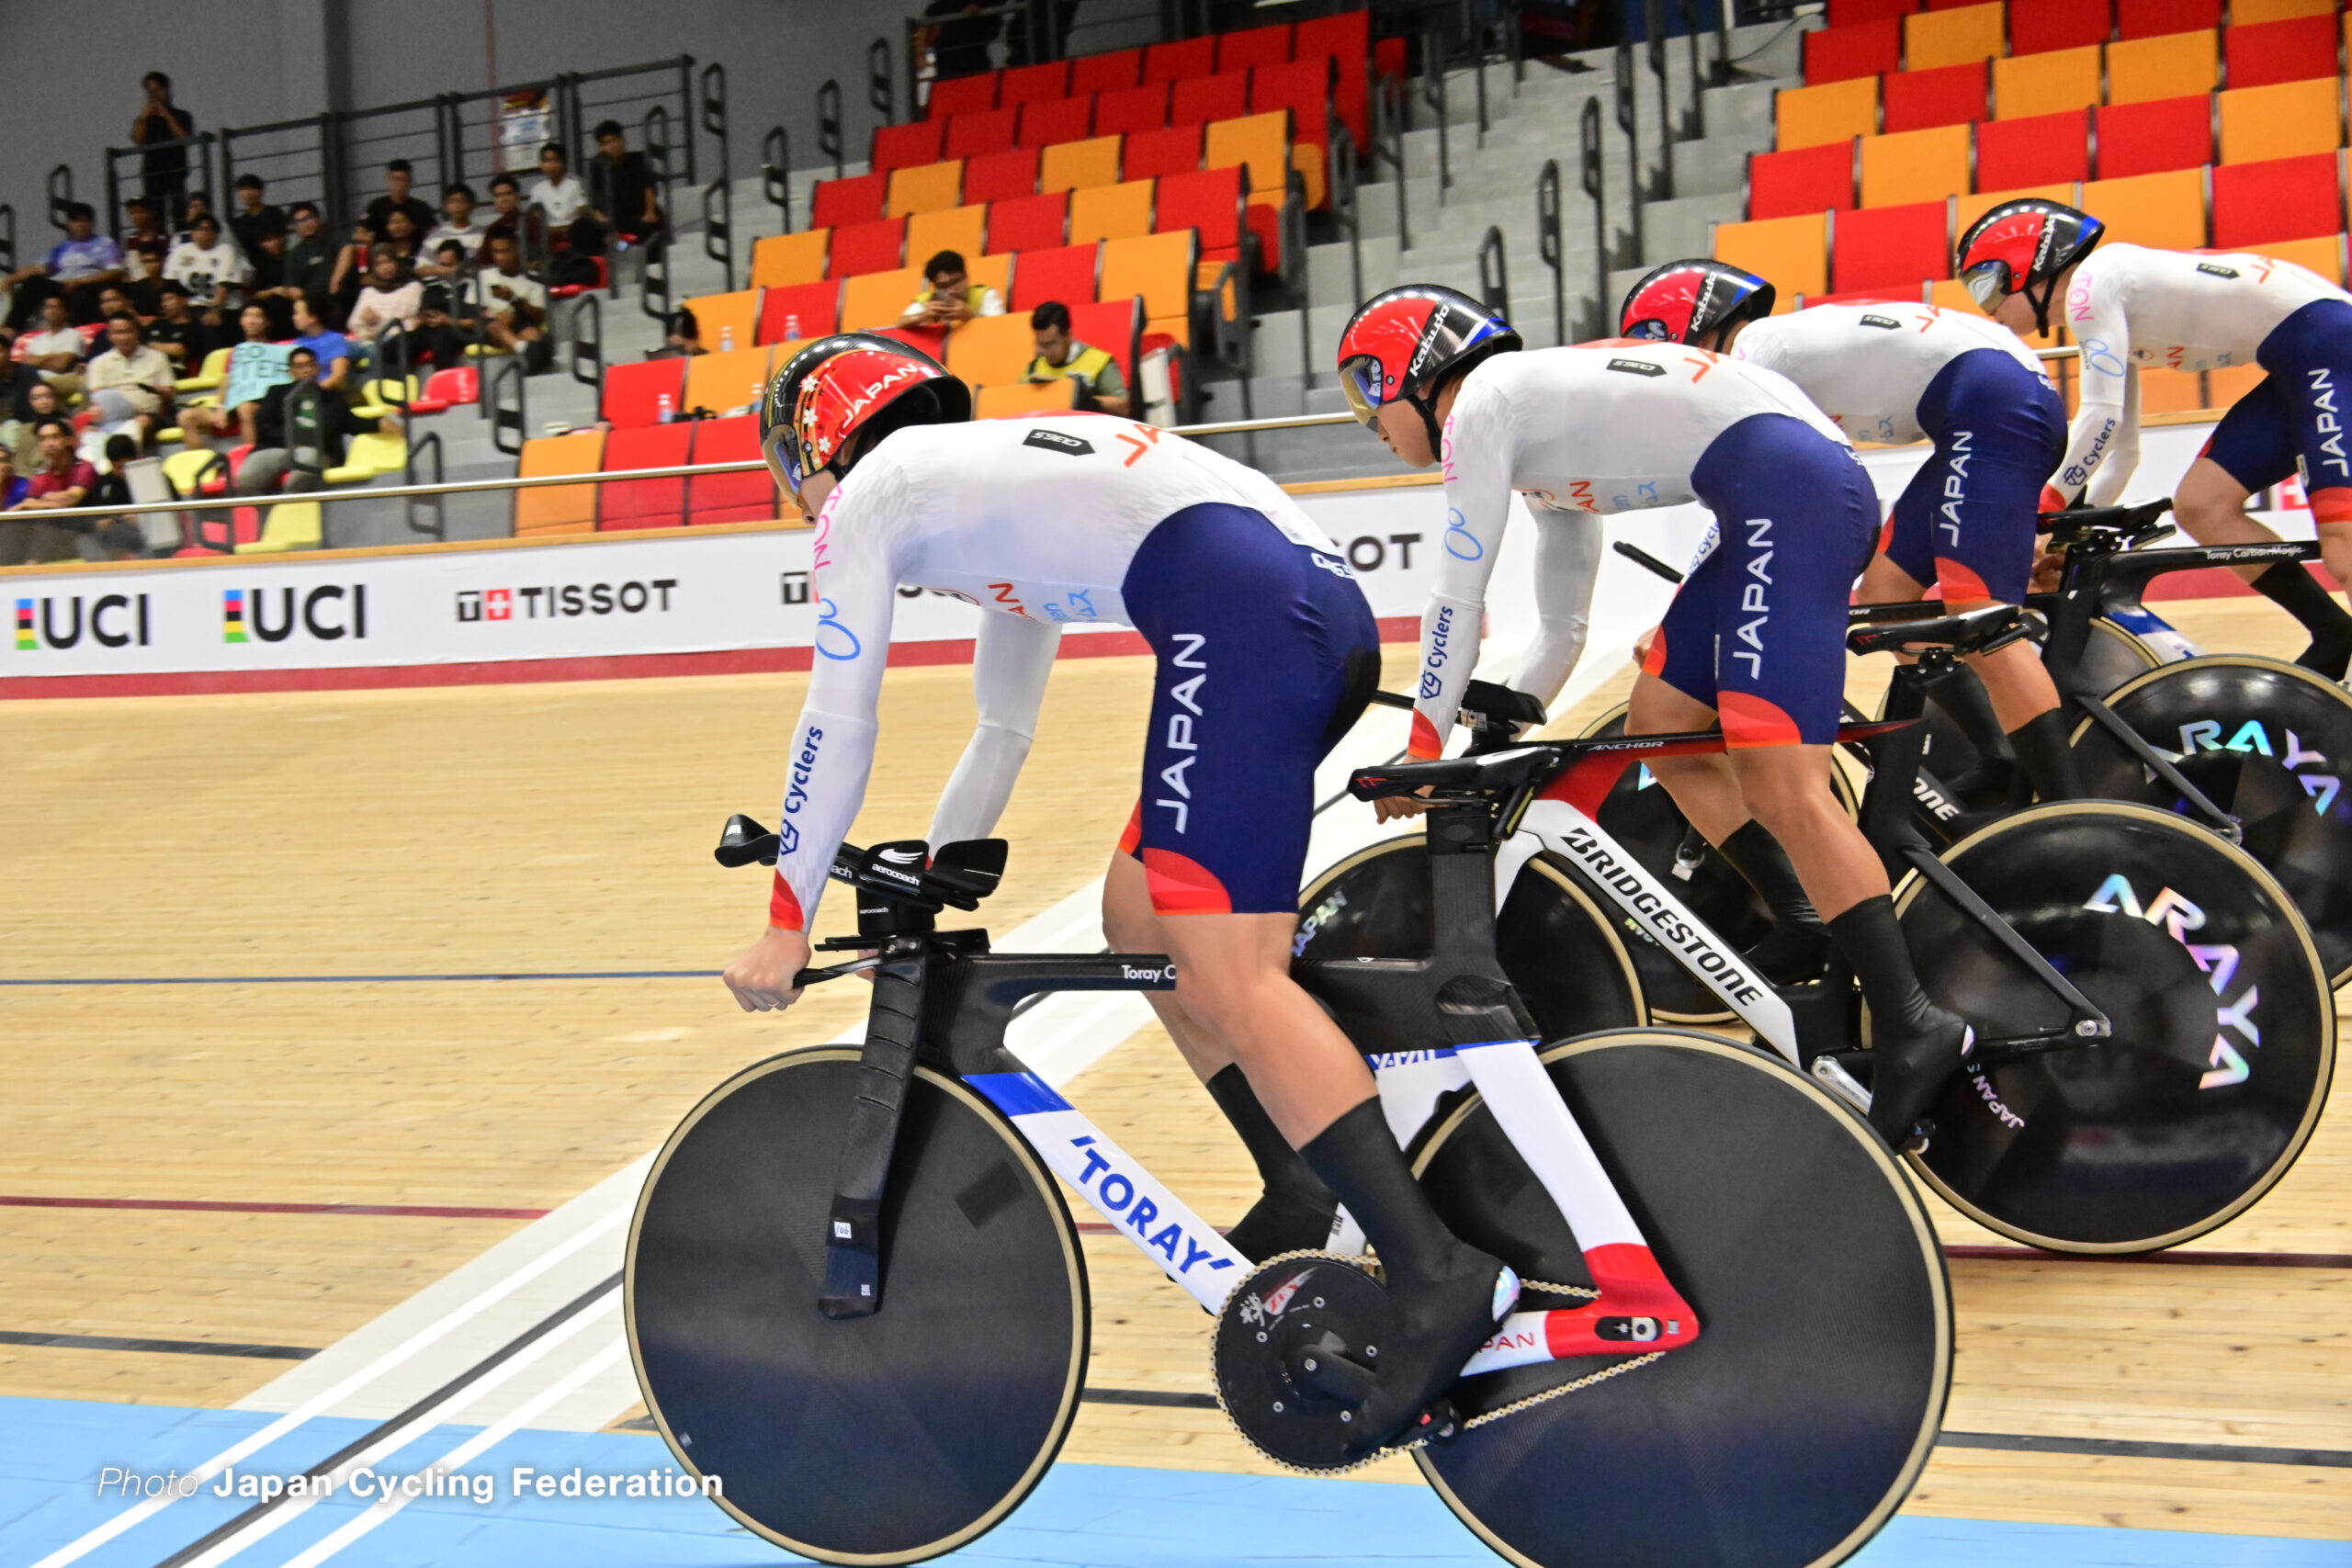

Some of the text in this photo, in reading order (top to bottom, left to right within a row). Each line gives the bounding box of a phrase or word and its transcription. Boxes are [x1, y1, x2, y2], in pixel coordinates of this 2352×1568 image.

[1690, 272, 1717, 332] Kabuto
[1409, 305, 1449, 378] Kabuto
[842, 363, 919, 428] JAPAN
[2308, 368, 2350, 477] JAPAN
[2083, 418, 2116, 467] Cyclers
[1939, 431, 1973, 547] JAPAN
[2206, 551, 2233, 560] Toray
[40, 593, 151, 649] UCI
[252, 584, 367, 642] UCI
[519, 579, 678, 619] TISSOT
[1733, 518, 1773, 681] JAPAN
[1428, 606, 1453, 668] Cyclers
[1156, 634, 1207, 834] JAPAN
[1588, 741, 1664, 750] ANCHOR
[785, 726, 823, 814] Cyclers
[872, 863, 921, 886] aerocoach
[1560, 828, 1763, 1007] BRIDGESTONE
[1122, 964, 1161, 983] Toray
[2082, 874, 2260, 1089] ARAYA
[1973, 1075, 2025, 1128] JAPAN
